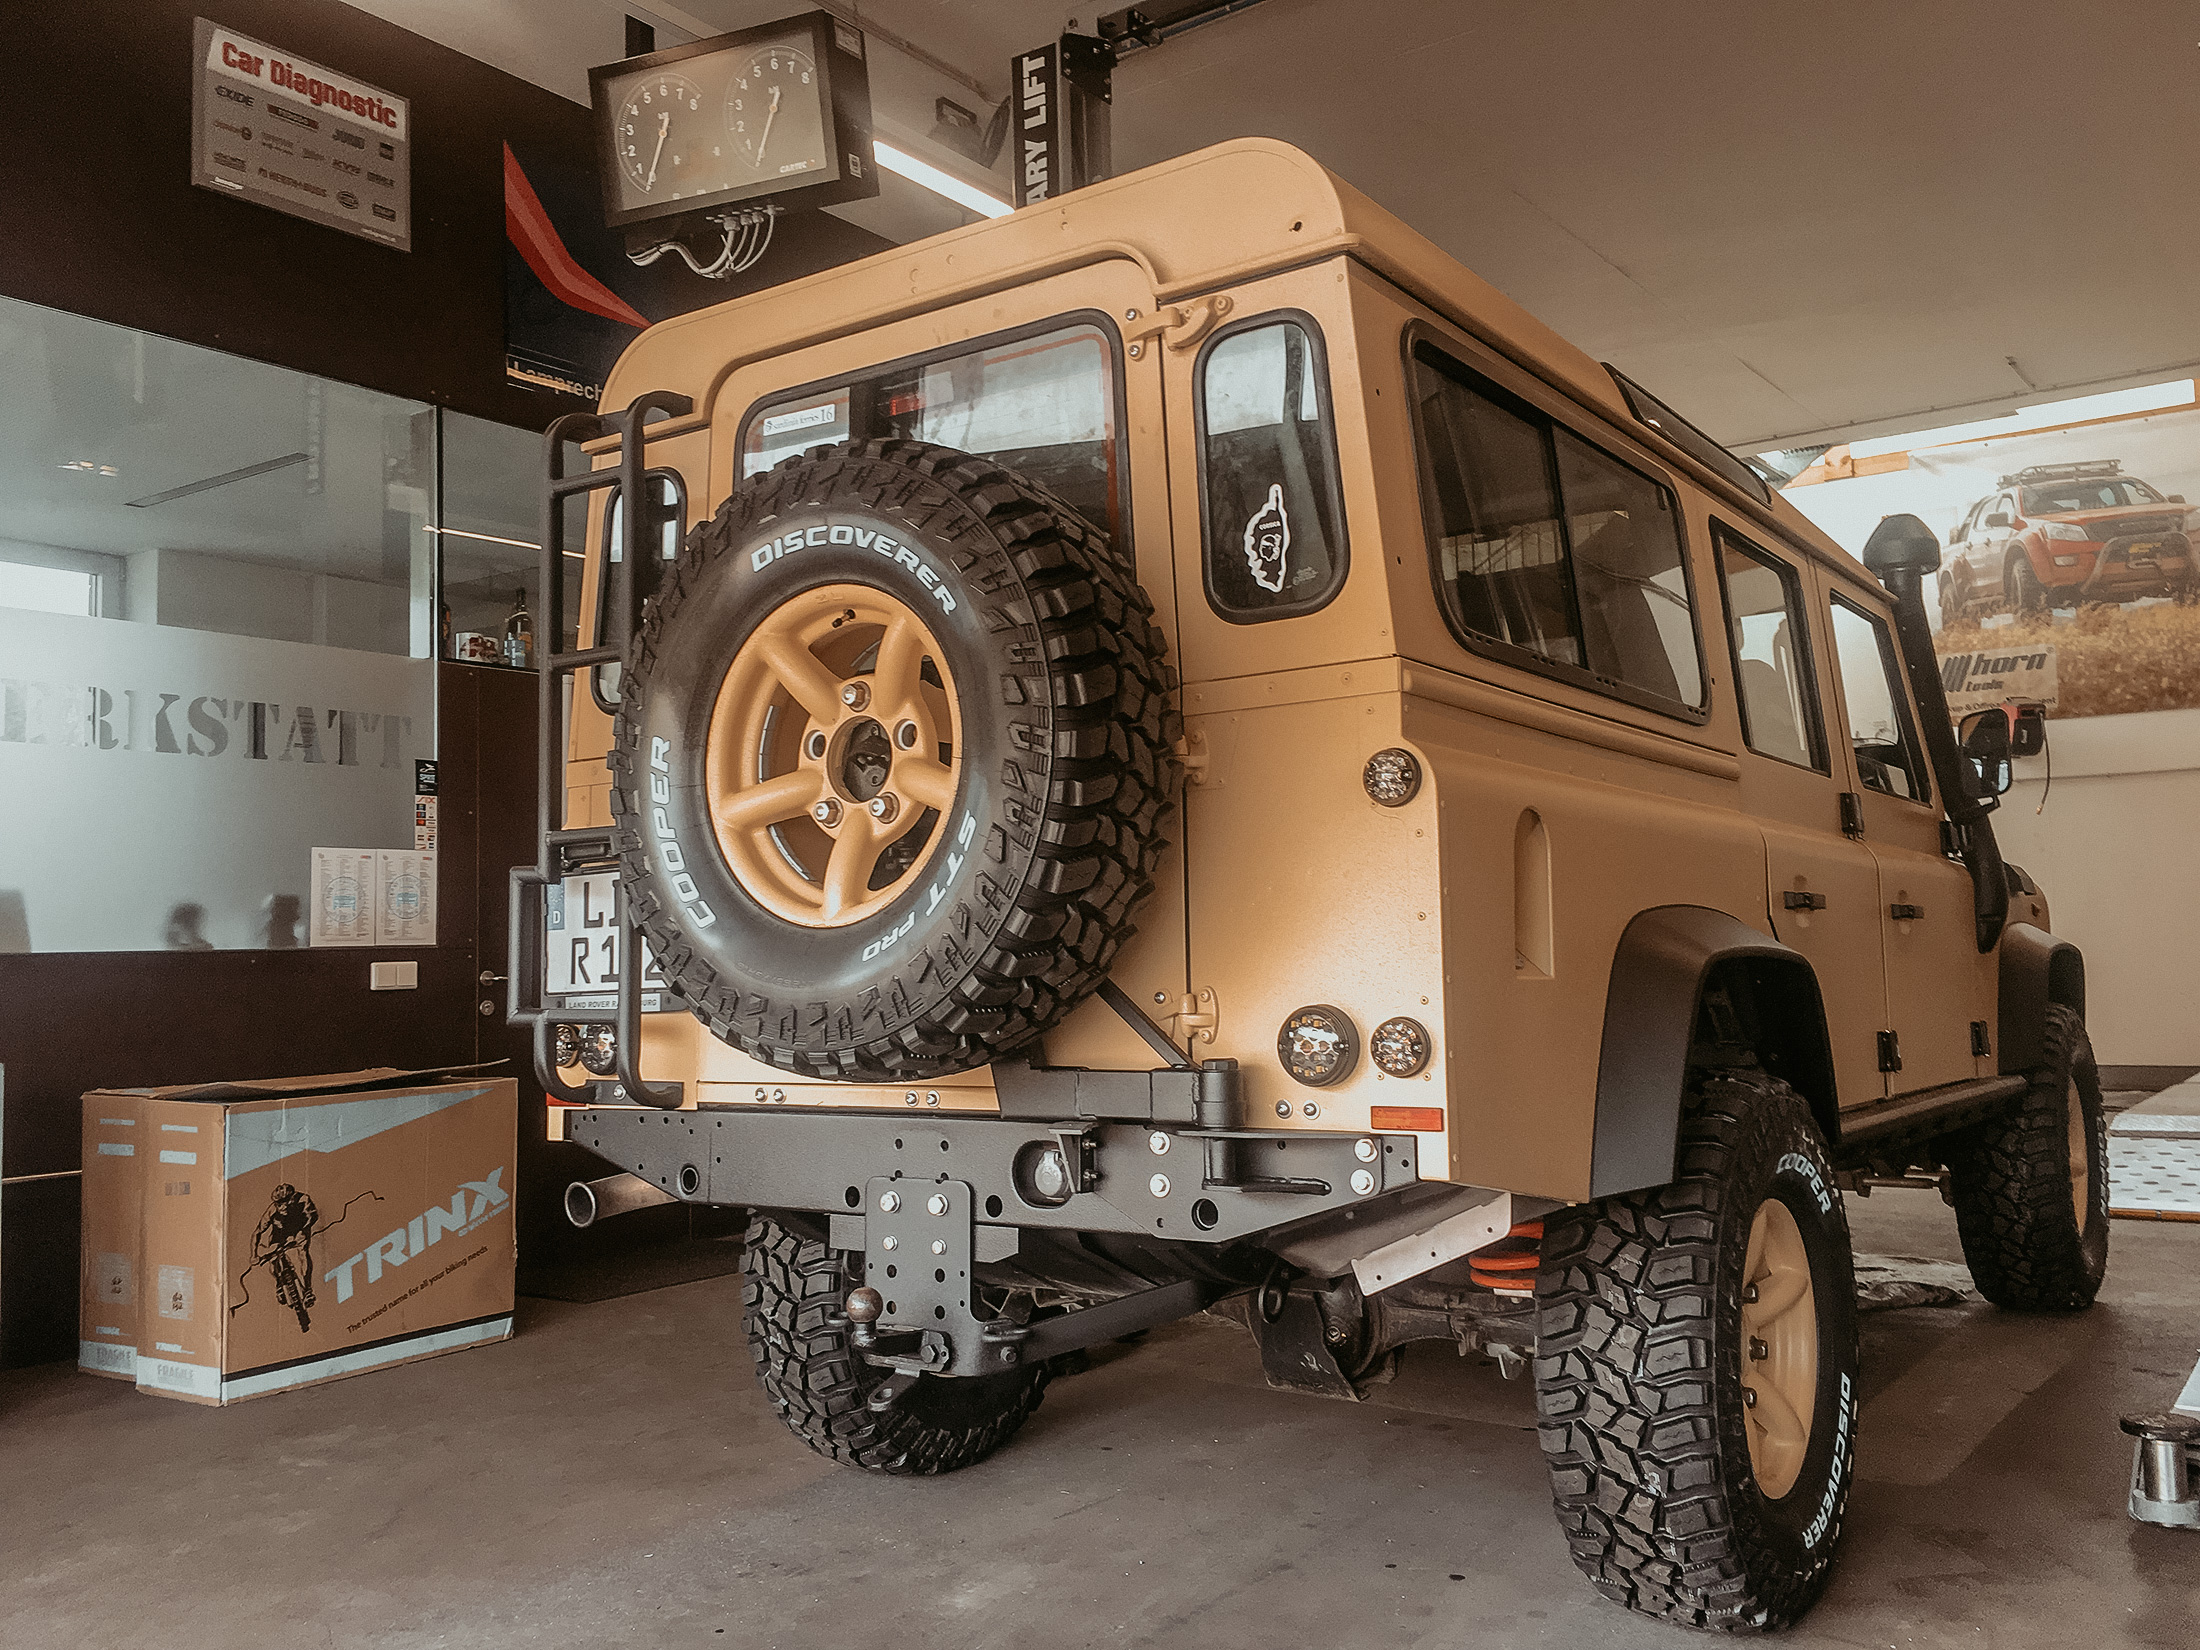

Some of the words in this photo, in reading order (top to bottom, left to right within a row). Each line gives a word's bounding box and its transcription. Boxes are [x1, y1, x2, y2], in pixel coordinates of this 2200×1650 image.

[770, 57, 779, 70] 6
[788, 61, 795, 73] 7
[753, 65, 761, 78] 5
[801, 72, 810, 84] 8
[222, 41, 264, 77] Car
[270, 59, 397, 129] Diagnostic
[660, 84, 668, 97] 6
[740, 78, 748, 90] 4
[643, 92, 652, 104] 5
[676, 88, 684, 100] 7
[1022, 56, 1047, 130] LIFT
[631, 104, 639, 116] 4
[690, 98, 698, 111] 8
[735, 99, 743, 111] 3
[626, 124, 635, 136] 3
[736, 121, 744, 133] 2
[745, 138, 751, 150] 1
[627, 145, 636, 157] 2
[636, 163, 643, 174] 1
[820, 408, 834, 422] 16
[751, 525, 957, 616] DISCOVERER
[1972, 653, 2048, 676] horn
[1966, 680, 2004, 692] tools
[650, 736, 717, 929] COOPER
[925, 809, 977, 917] STT
[552, 910, 561, 924] D
[862, 911, 915, 962] PRO
[568, 1001, 586, 1009] LAND
[588, 1000, 610, 1008] ROVER
[1776, 1152, 1832, 1215] COOPER
[324, 1166, 510, 1304] TRINX
[346, 1321, 362, 1334] The
[362, 1303, 387, 1325] trusted
[388, 1294, 408, 1309] name
[408, 1286, 419, 1297] for
[420, 1278, 429, 1290] all
[429, 1270, 445, 1287] your
[445, 1257, 467, 1275] biking
[468, 1245, 489, 1262] needs
[1801, 1371, 1851, 1550] DISCOVERER
